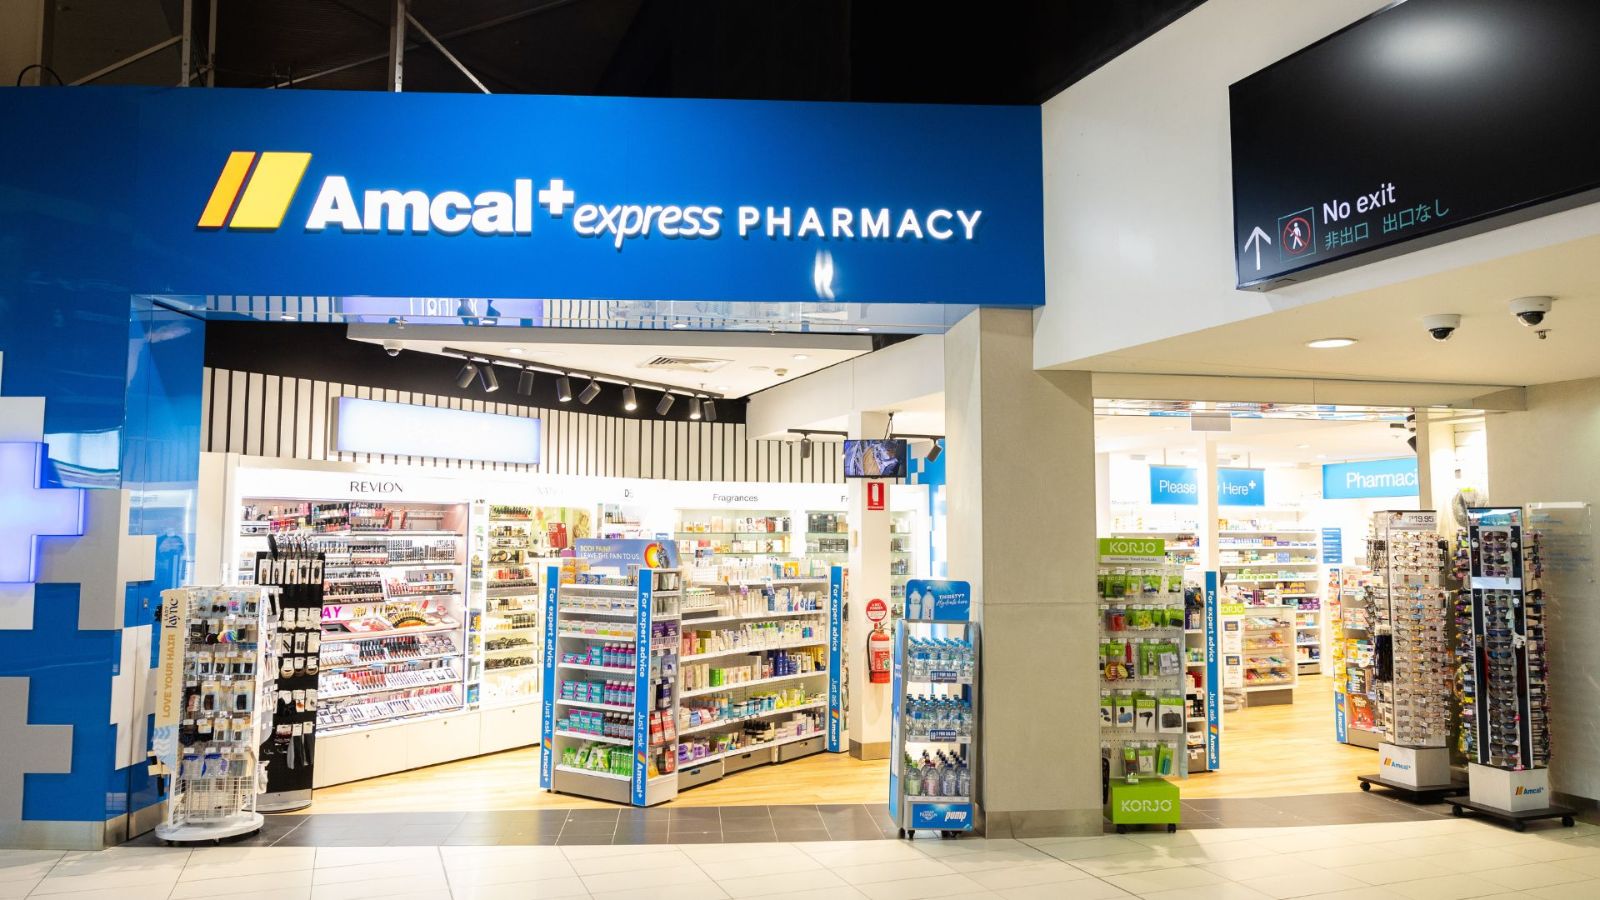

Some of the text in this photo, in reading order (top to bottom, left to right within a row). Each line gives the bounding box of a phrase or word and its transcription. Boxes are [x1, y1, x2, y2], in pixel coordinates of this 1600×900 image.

[1322, 181, 1396, 225] No exit
[572, 202, 723, 249] express
[737, 205, 983, 241] PHARMACY
[1324, 199, 1450, 251] 非出口 出口なし
[349, 480, 404, 493] REVLON
[1159, 478, 1197, 496] Please
[712, 493, 760, 505] Fragrances
[1109, 541, 1156, 554] KORJO
[546, 605, 554, 637] expert
[1207, 590, 1216, 664] For expert advice
[639, 592, 649, 678] For expert advice
[546, 638, 554, 669] advice
[163, 634, 176, 718] LOVE YOUR HAIR
[544, 700, 552, 719] Just
[1209, 711, 1217, 723] ask
[544, 719, 552, 735] ask
[637, 711, 645, 731] Just
[637, 731, 645, 748] ask
[1120, 799, 1173, 813] KORJO
[944, 811, 967, 822] pump
